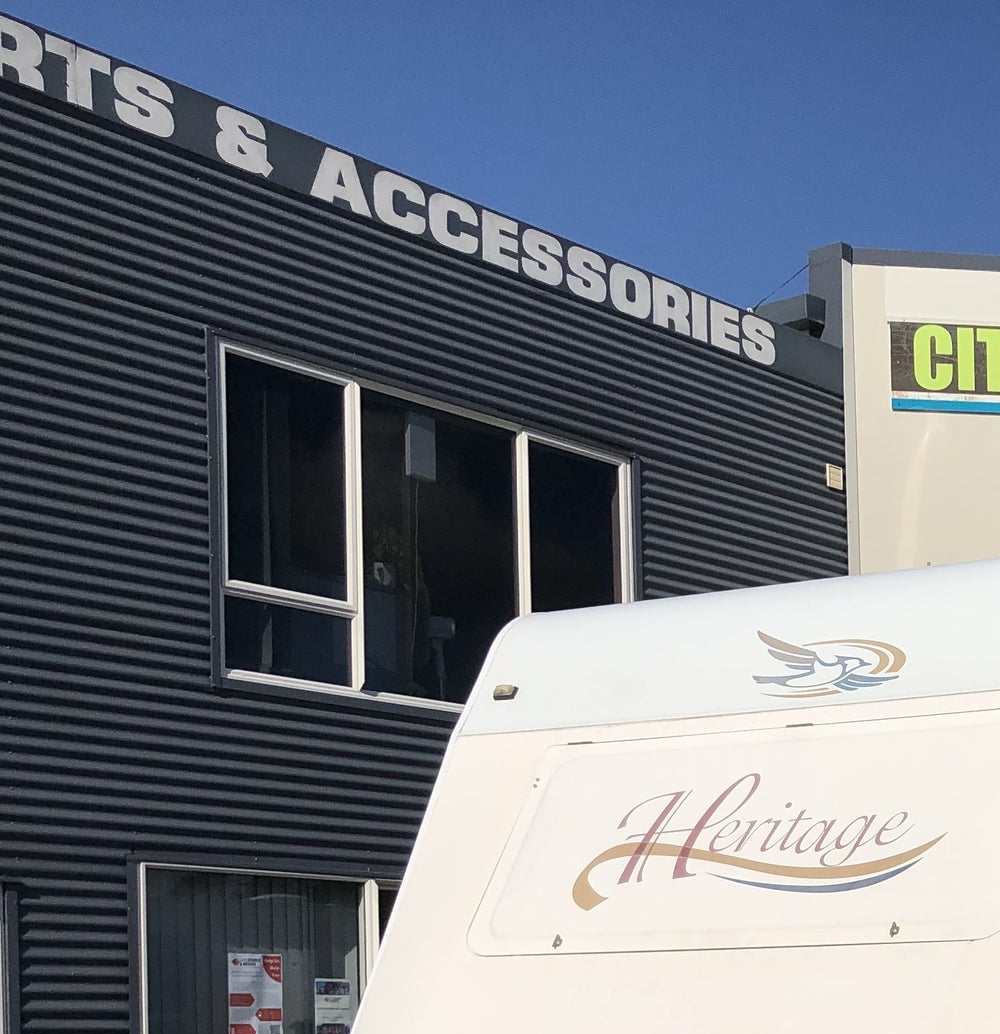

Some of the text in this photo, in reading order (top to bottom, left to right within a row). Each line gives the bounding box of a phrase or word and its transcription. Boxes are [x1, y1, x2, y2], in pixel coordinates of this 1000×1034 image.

[215, 105, 274, 178] &
[310, 147, 776, 366] ACCESSORIES
[617, 773, 915, 884] Heritage
